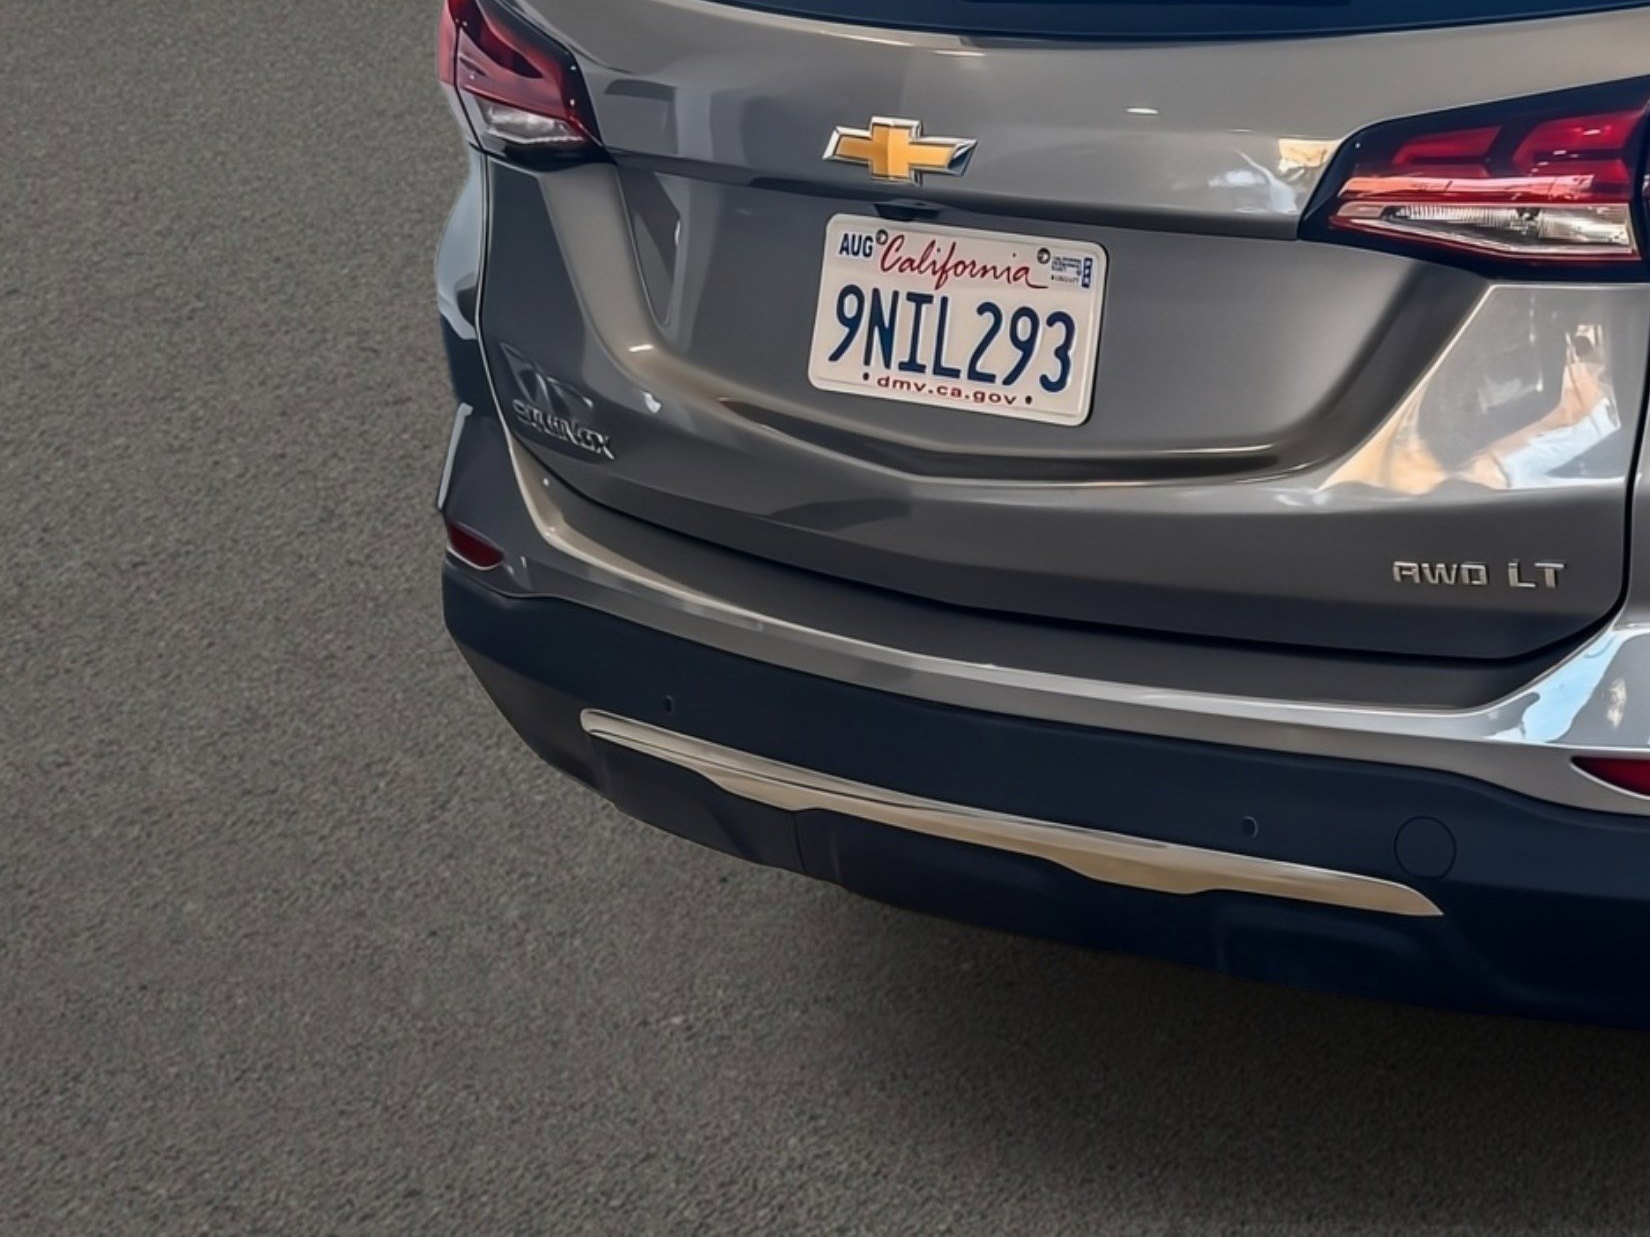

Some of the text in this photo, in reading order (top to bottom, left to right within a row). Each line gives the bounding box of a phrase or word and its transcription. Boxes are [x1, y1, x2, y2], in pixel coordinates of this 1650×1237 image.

[838, 232, 874, 258] AUG
[880, 234, 1049, 290] California
[828, 284, 1076, 393] 9NIL293
[876, 376, 1017, 405] dmv.ca.gov
[1392, 559, 1566, 589] AWD LT
